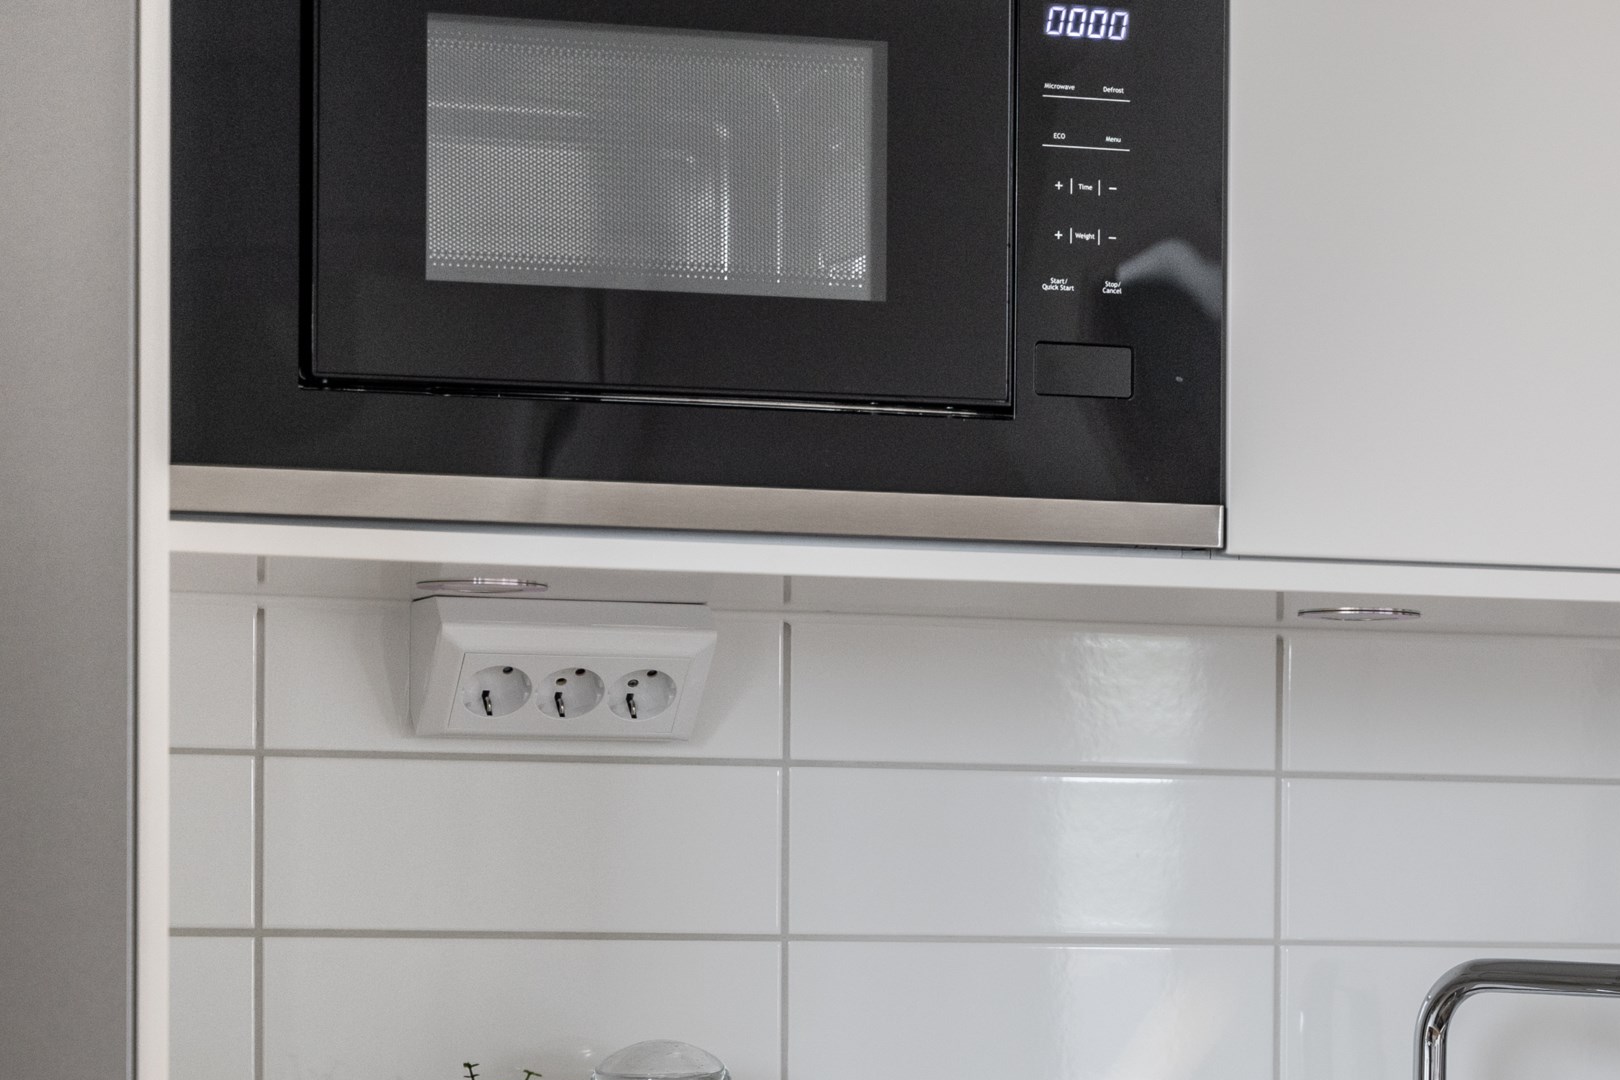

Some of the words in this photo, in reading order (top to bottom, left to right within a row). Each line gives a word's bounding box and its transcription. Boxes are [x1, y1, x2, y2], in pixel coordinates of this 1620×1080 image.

[1046, 5, 1129, 40] 0000
[1043, 82, 1076, 91] Microwave
[1102, 86, 1124, 94] Defrost
[1053, 132, 1066, 140] ECO
[1078, 183, 1093, 191] Time
[1074, 232, 1095, 241] Weight
[1050, 277, 1068, 285] Start/
[1104, 280, 1121, 289] Stop/
[1041, 283, 1059, 291] Quick
[1060, 284, 1075, 292] Start
[1102, 287, 1122, 295] Cancel
